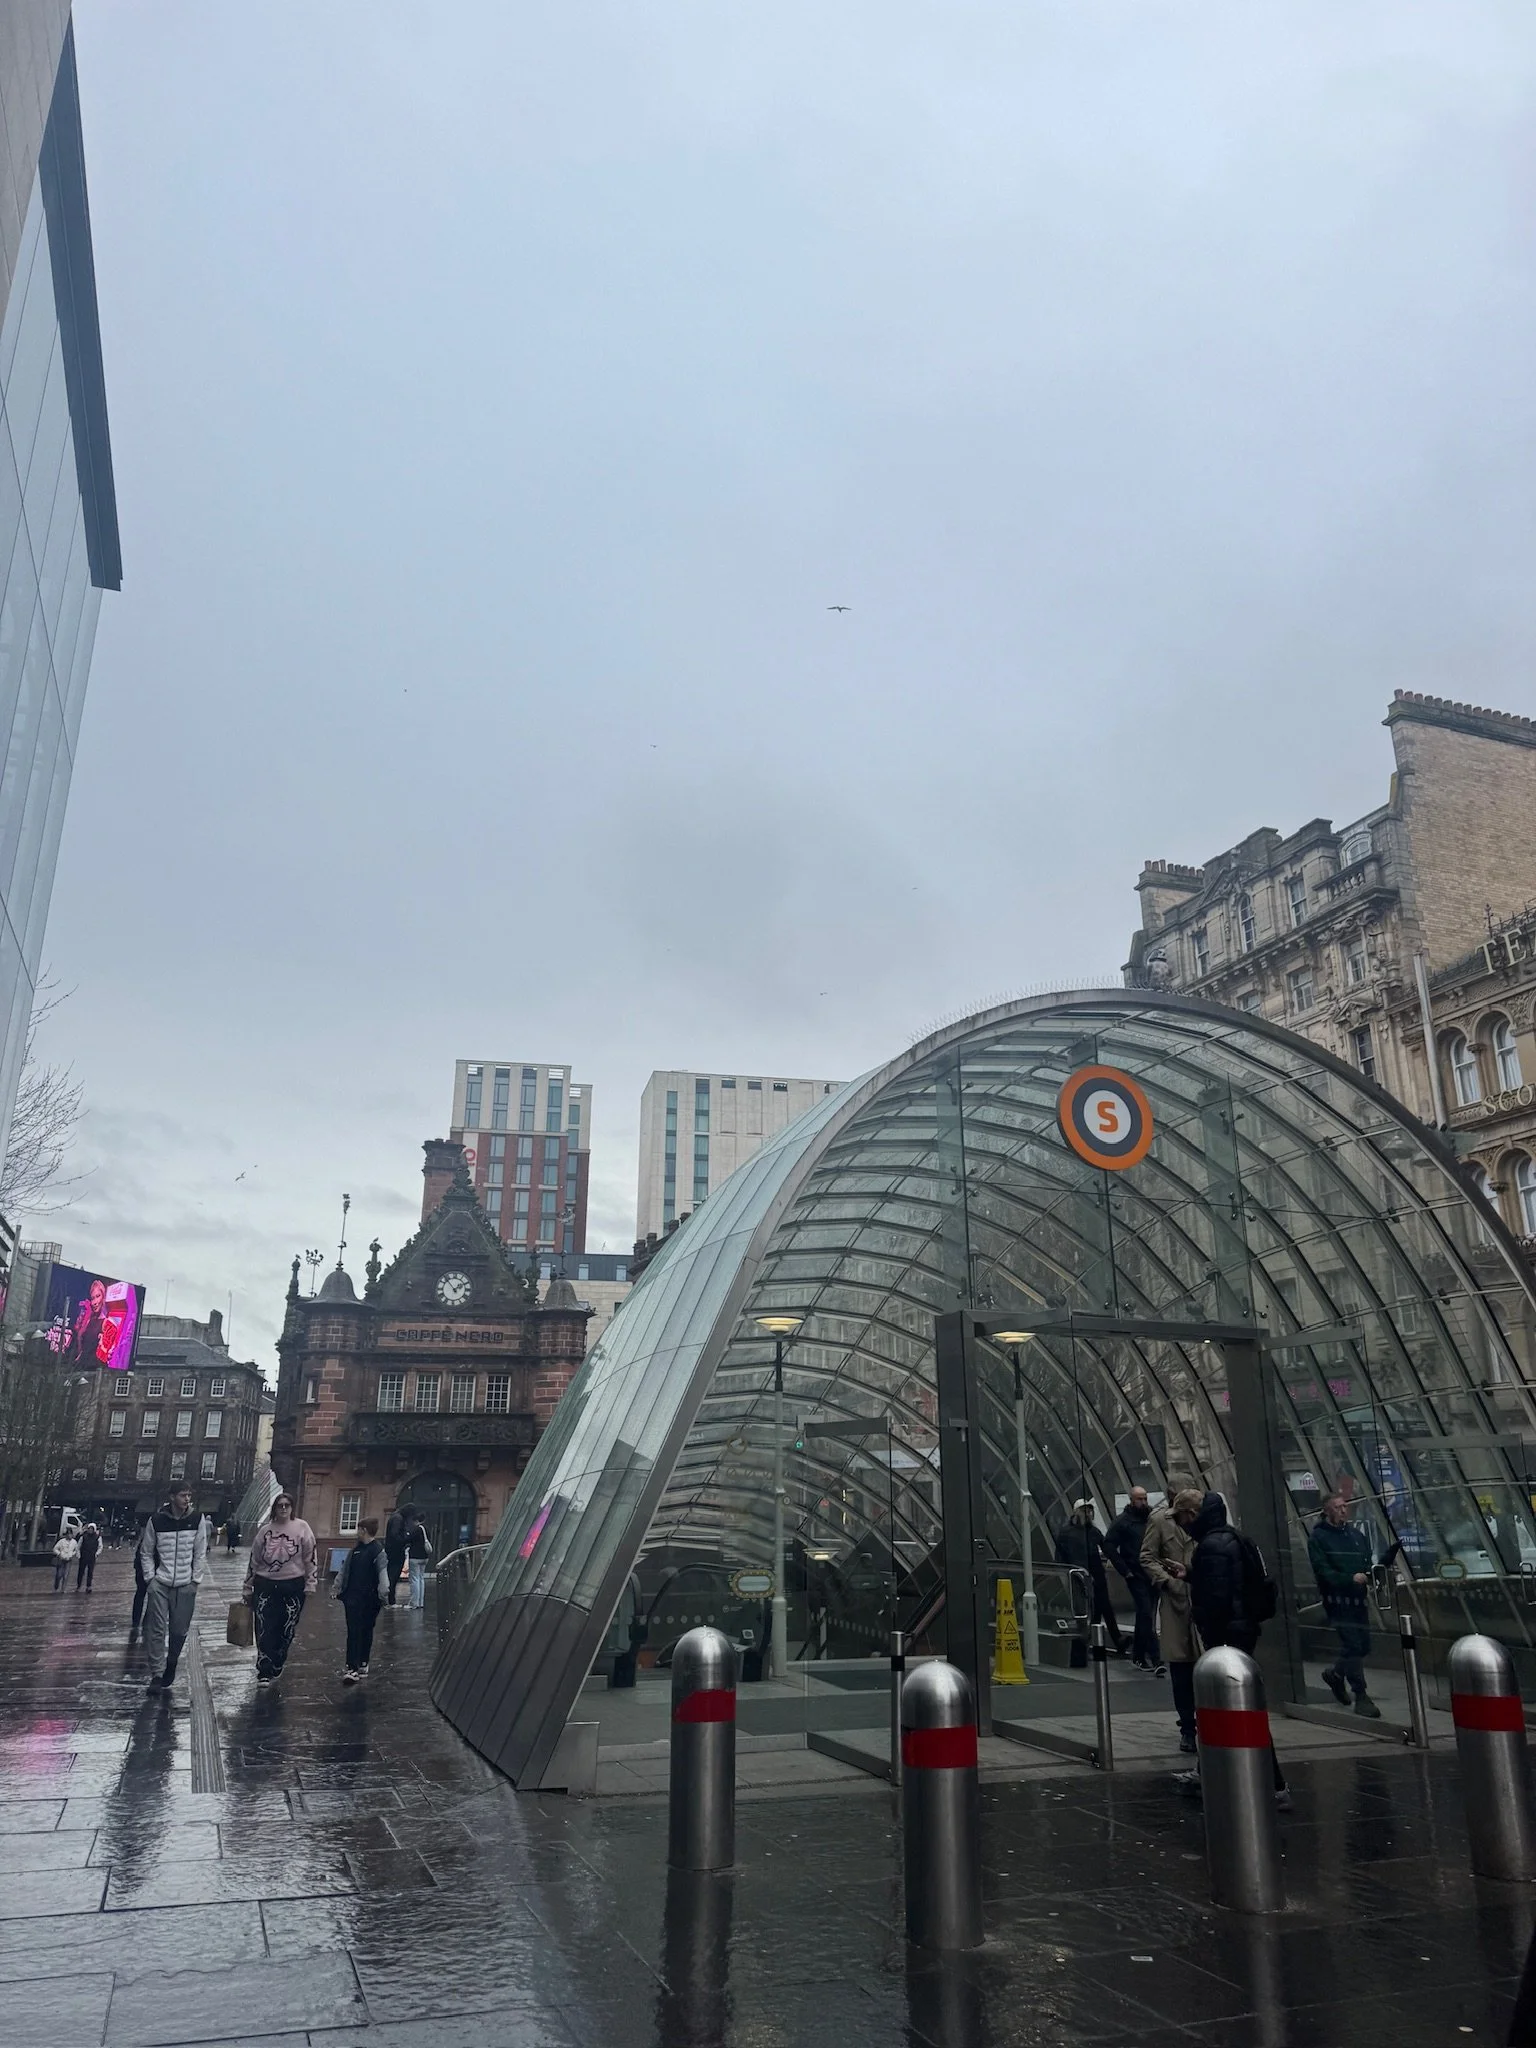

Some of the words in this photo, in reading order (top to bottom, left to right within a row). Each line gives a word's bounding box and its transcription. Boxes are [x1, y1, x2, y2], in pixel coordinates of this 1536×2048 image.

[1475, 928, 1536, 976] TE
[1096, 1100, 1120, 1134] S
[455, 1330, 505, 1343] NERO
